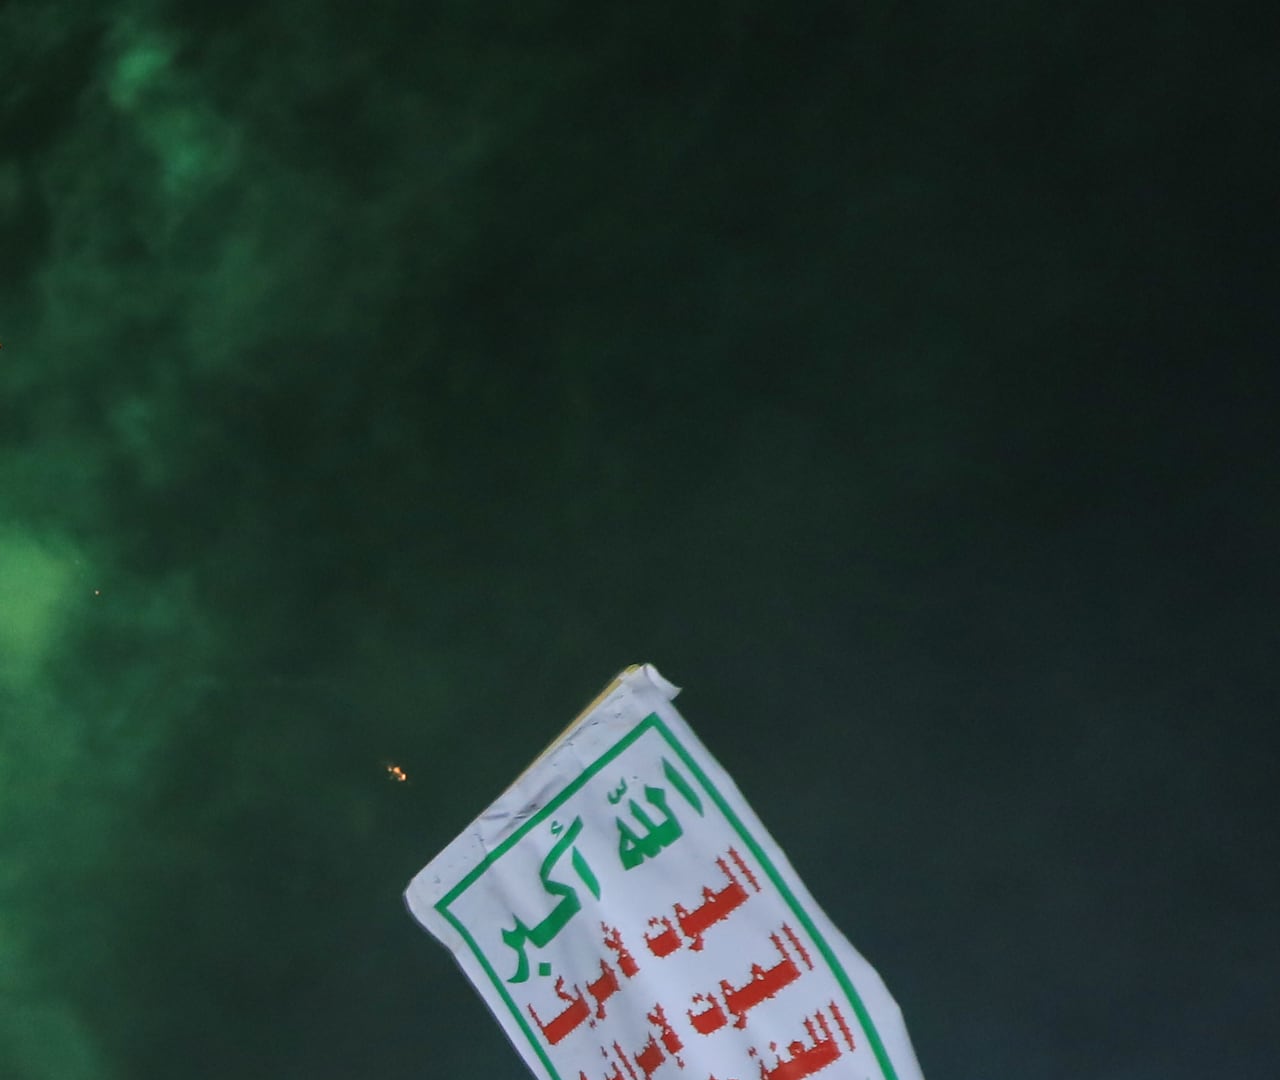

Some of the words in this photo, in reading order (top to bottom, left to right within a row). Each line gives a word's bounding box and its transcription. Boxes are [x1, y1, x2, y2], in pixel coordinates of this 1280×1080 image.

[611, 757, 704, 872] الله
[500, 813, 601, 984] أكبر
[643, 846, 761, 960] الموت
[527, 922, 639, 1045] لأمريكا
[687, 923, 815, 1034] الموت
